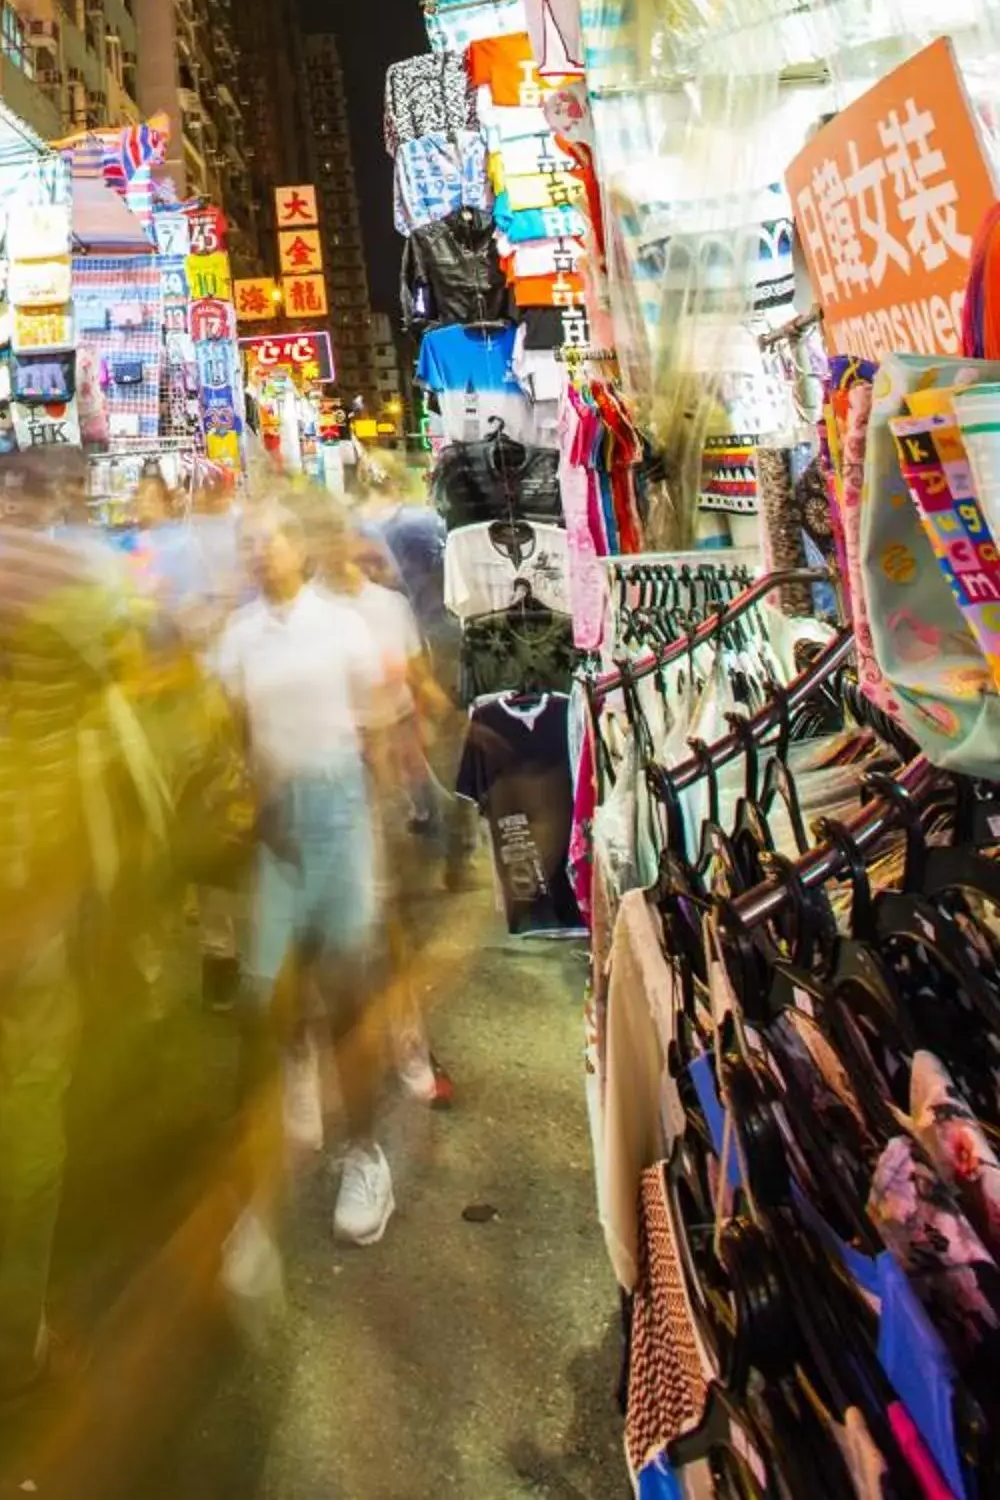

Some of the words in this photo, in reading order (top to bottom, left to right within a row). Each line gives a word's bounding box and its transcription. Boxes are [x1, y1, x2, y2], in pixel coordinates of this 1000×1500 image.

[282, 190, 322, 314] 大金龍
[797, 97, 974, 305] 日韓女裝
[28, 421, 71, 446] HK
